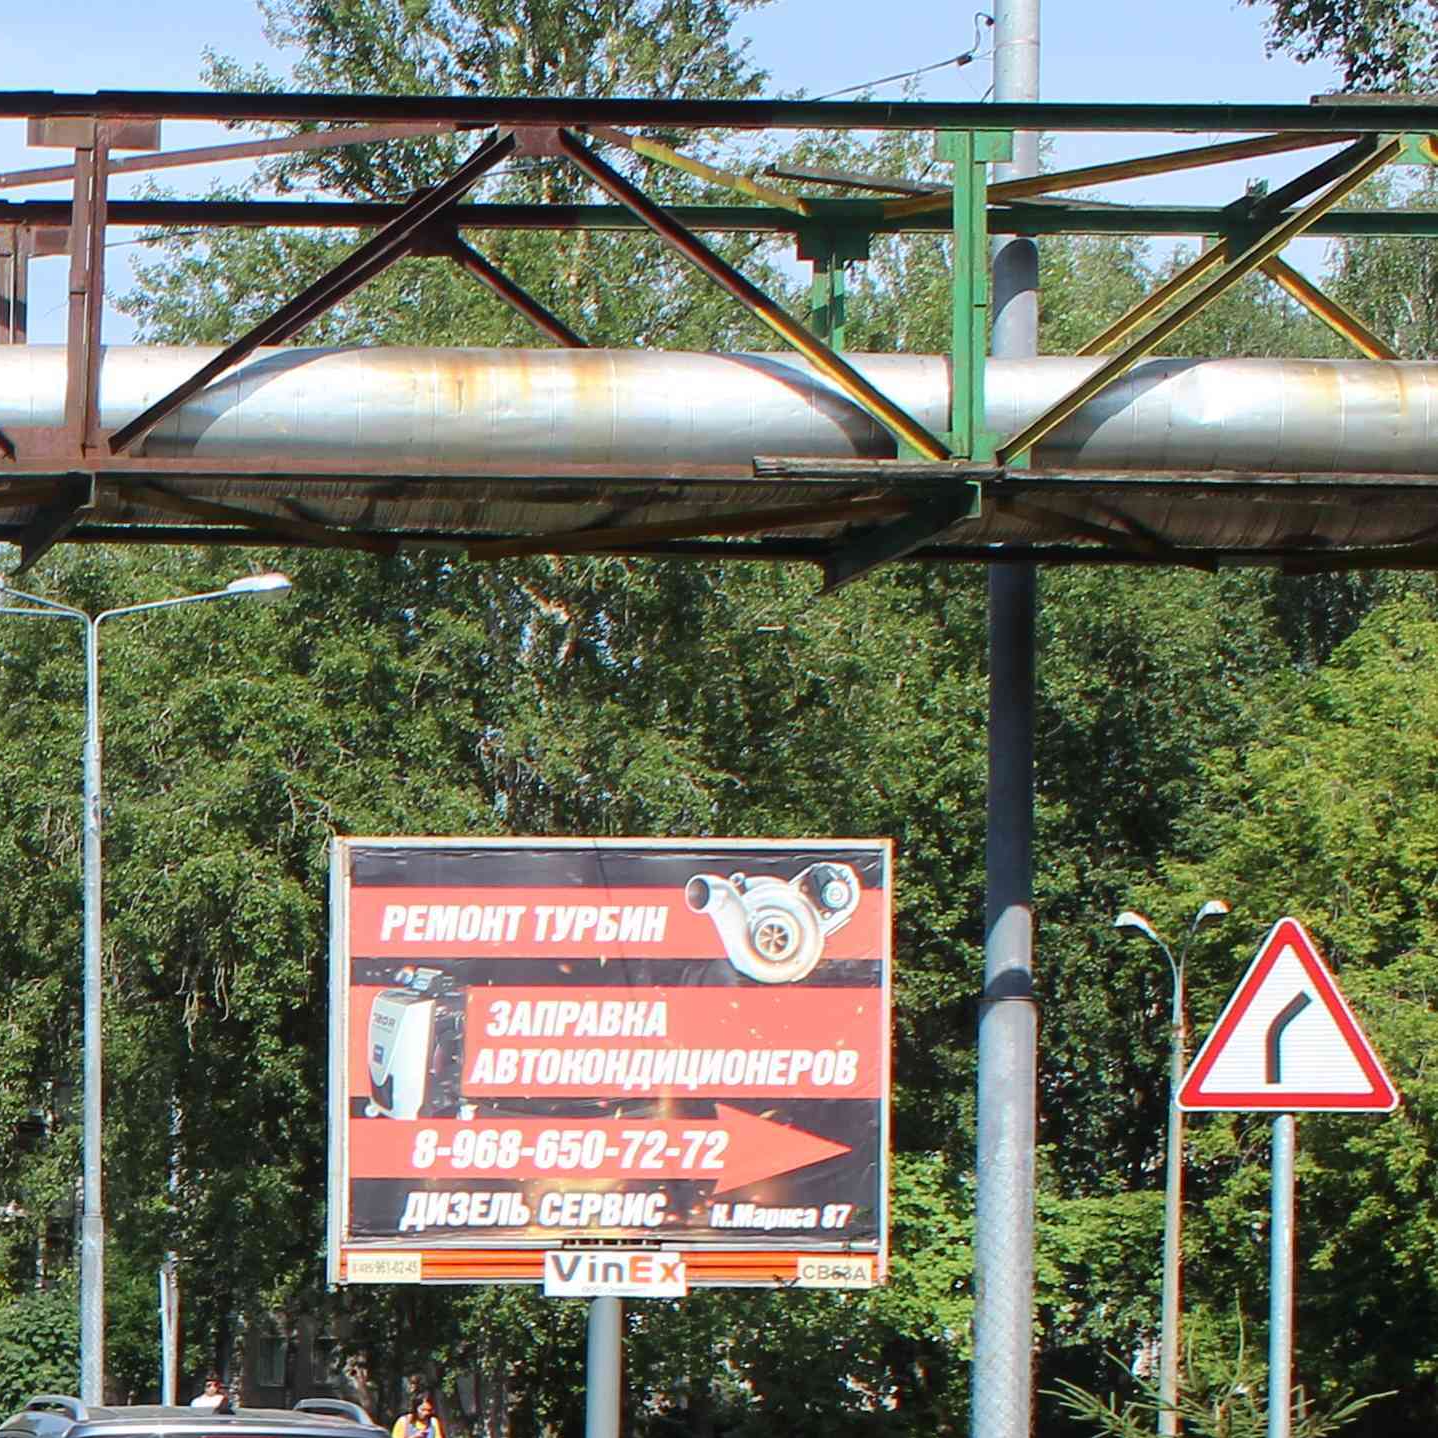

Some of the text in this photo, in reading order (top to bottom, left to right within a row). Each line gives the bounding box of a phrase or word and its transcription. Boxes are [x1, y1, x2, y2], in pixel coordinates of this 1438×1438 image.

[380, 905, 669, 943] РЕМОНТ ТУРБИН
[486, 1000, 667, 1037] ЗАПРАВКА
[470, 1048, 859, 1091] АВТОКОНДИЦИОНЕРОВ
[412, 1129, 730, 1170] 8-968-650-72-72
[398, 1191, 667, 1232] ДИЗЕЛЬ СЕРВИС
[821, 1204, 852, 1229] 87
[550, 1254, 681, 1284] VinEx
